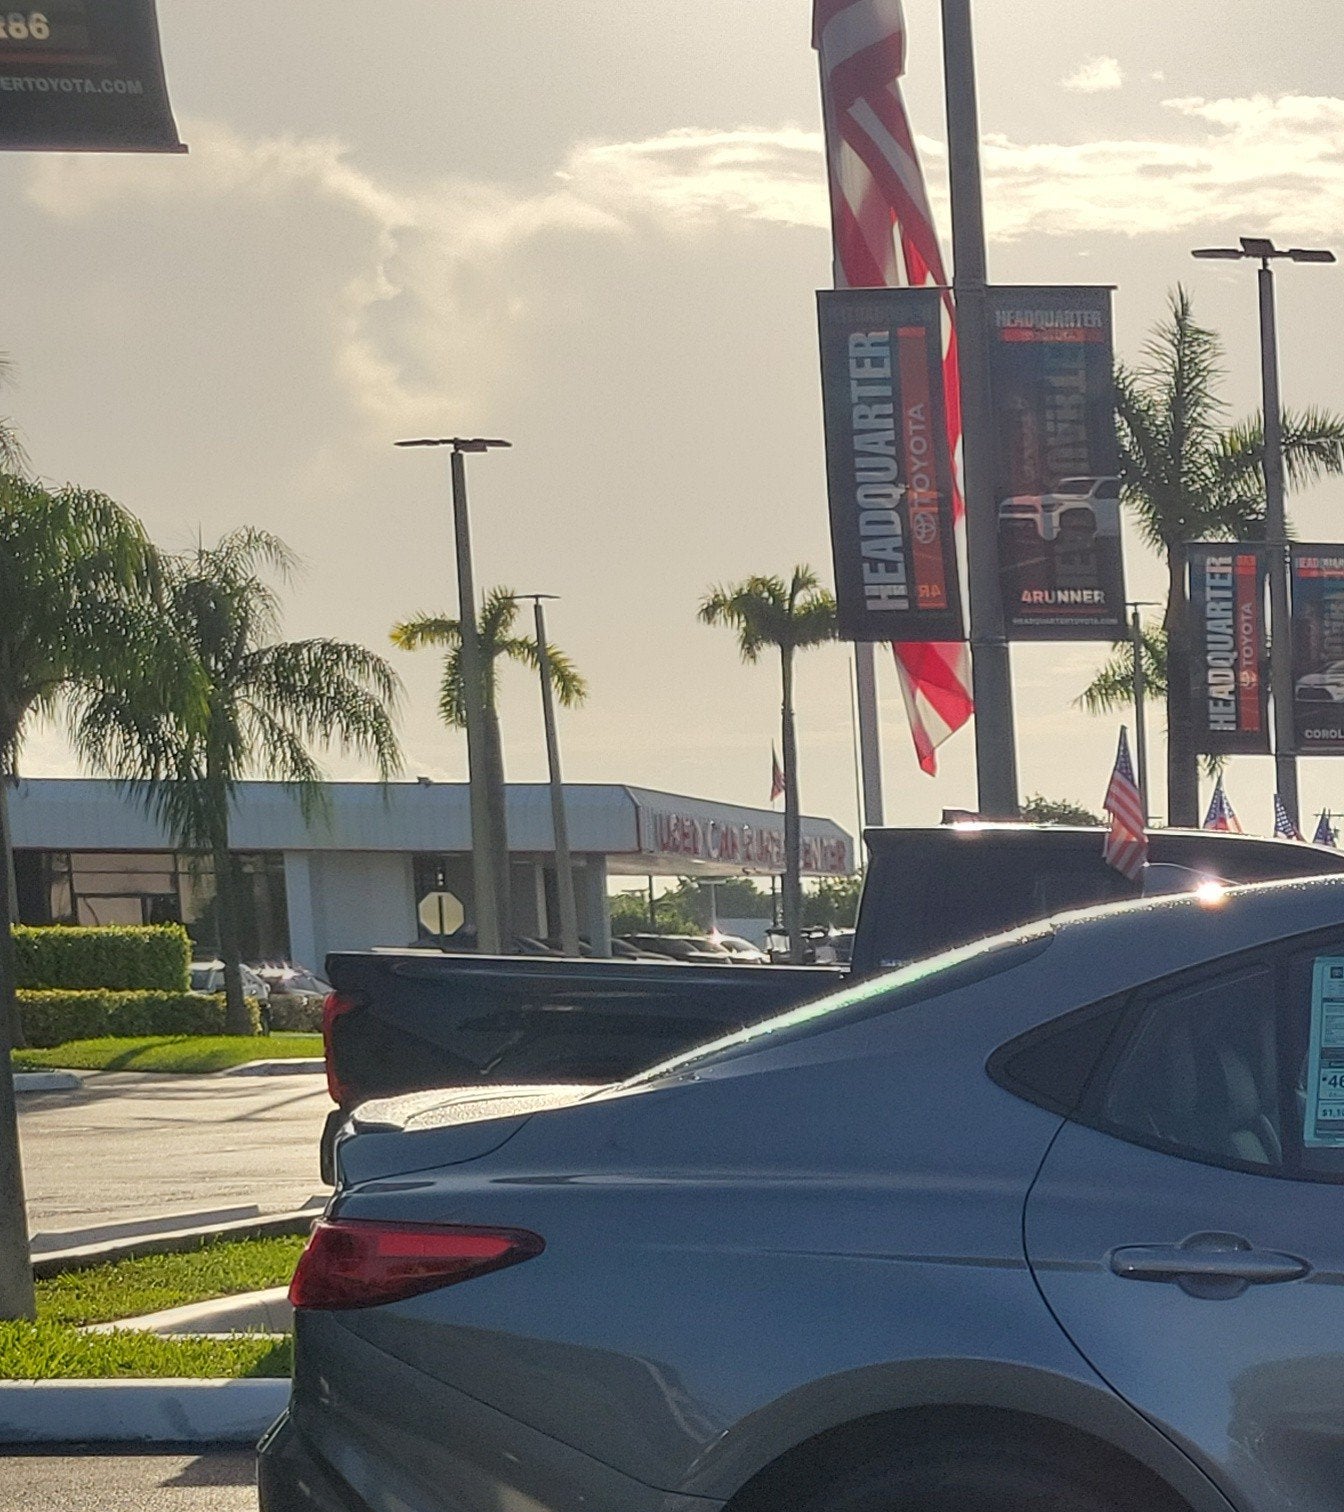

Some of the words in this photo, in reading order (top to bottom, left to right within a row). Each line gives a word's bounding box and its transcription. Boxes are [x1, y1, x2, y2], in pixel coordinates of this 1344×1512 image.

[995, 309, 1103, 329] HEADQUARTER
[848, 330, 910, 612] HEADQUARTER
[906, 404, 938, 509] TOYOTA
[1020, 589, 1106, 605] 4RUNNER
[1241, 602, 1254, 666] TOYOTA
[1205, 555, 1238, 732] HEADQUARTER
